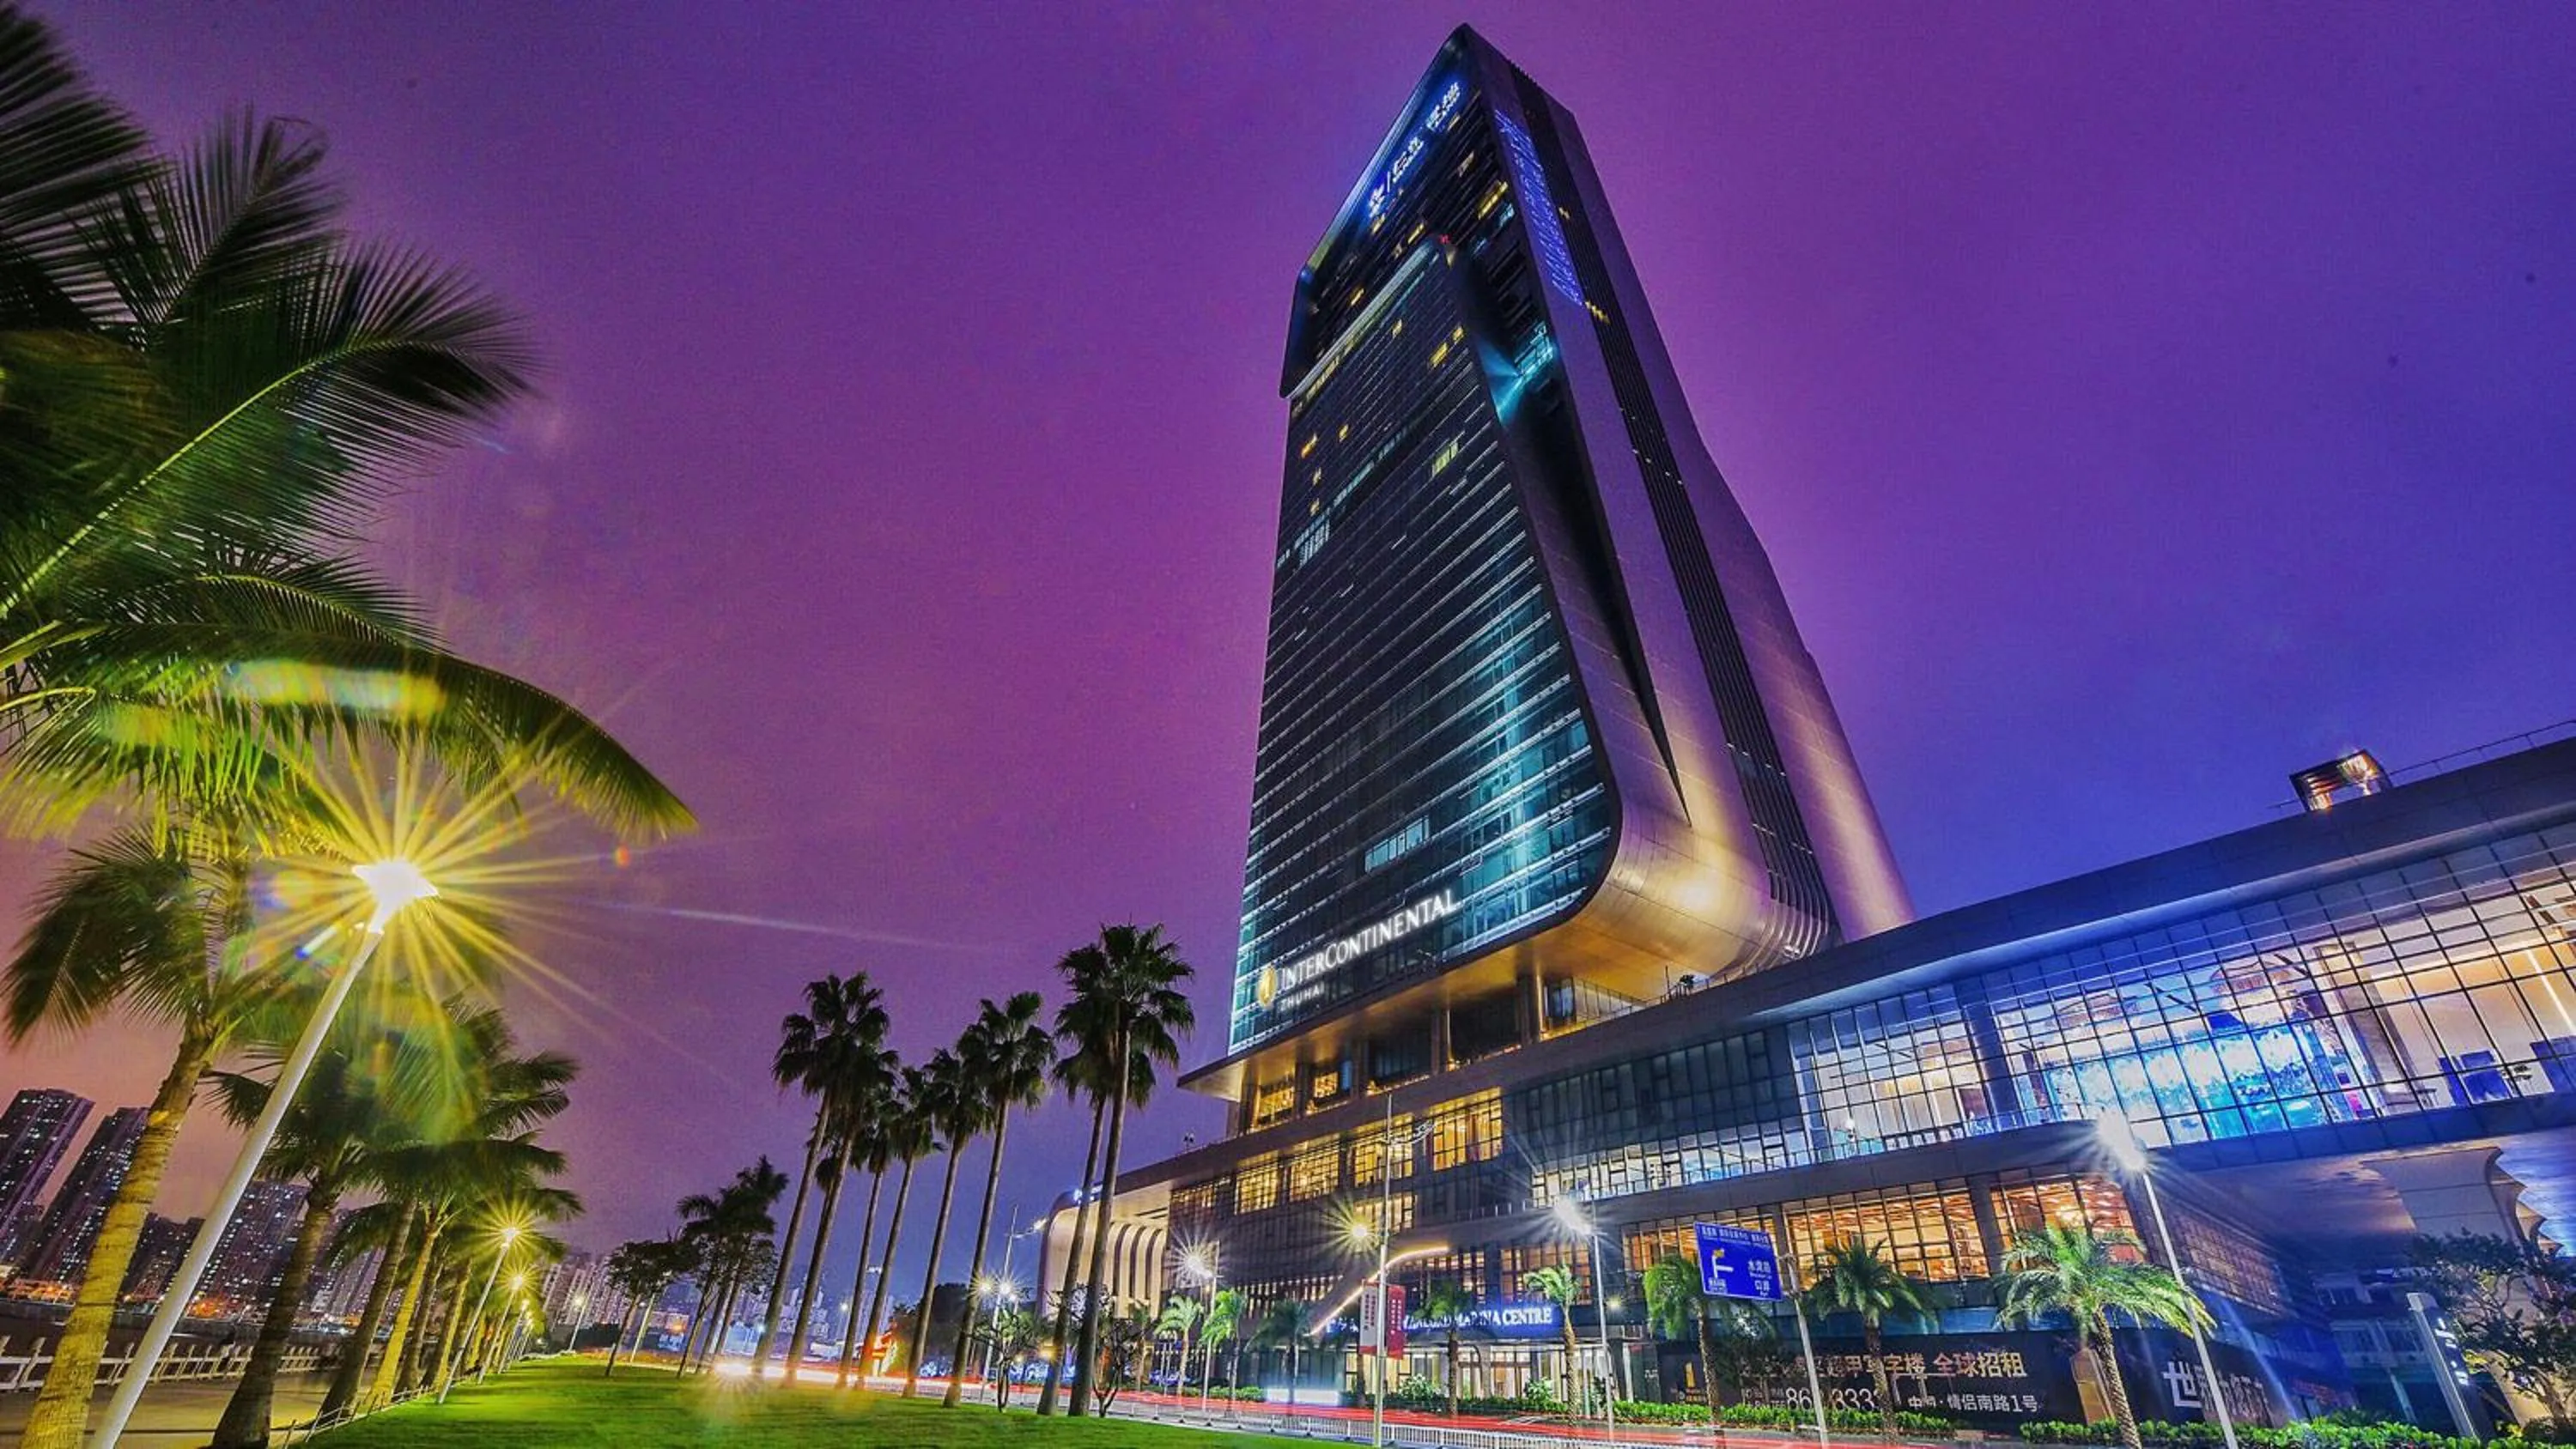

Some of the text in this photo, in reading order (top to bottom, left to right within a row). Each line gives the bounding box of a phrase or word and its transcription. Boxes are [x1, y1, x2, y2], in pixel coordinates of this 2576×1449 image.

[1281, 888, 1459, 990] INTERCONTINENTAL
[1503, 1307, 1552, 1326] CENTRE
[1933, 1351, 2028, 1378] 全球招租
